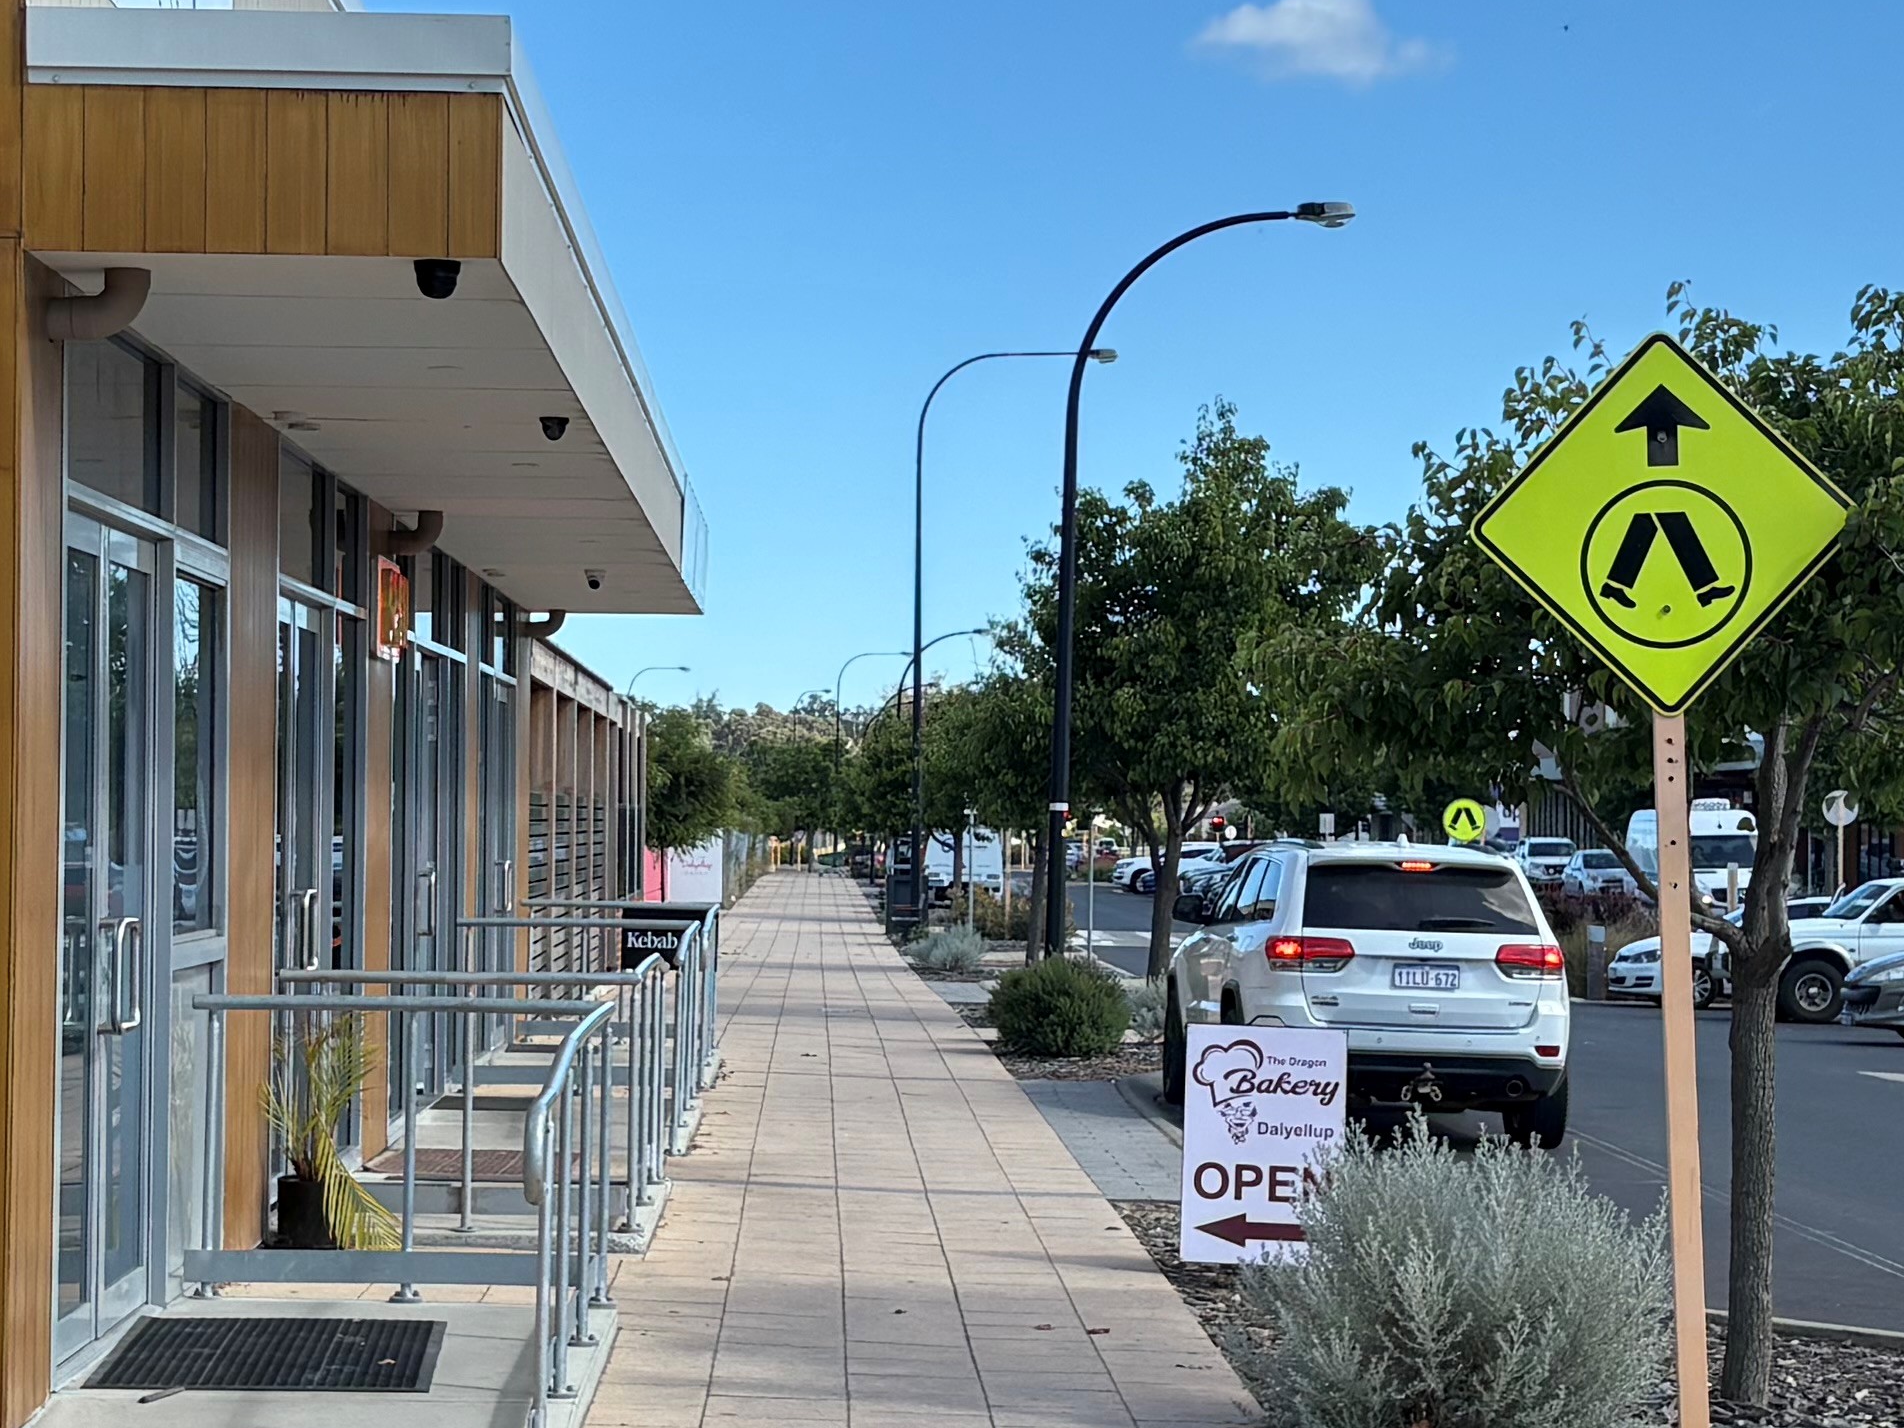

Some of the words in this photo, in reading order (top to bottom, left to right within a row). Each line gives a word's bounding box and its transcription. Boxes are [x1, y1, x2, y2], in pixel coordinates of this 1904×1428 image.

[626, 931, 678, 949] Kebab
[1267, 1055, 1286, 1066] The
[1289, 1057, 1327, 1068] Dragon
[1223, 1068, 1340, 1106] Bakery
[1257, 1121, 1335, 1141] Dalyellup
